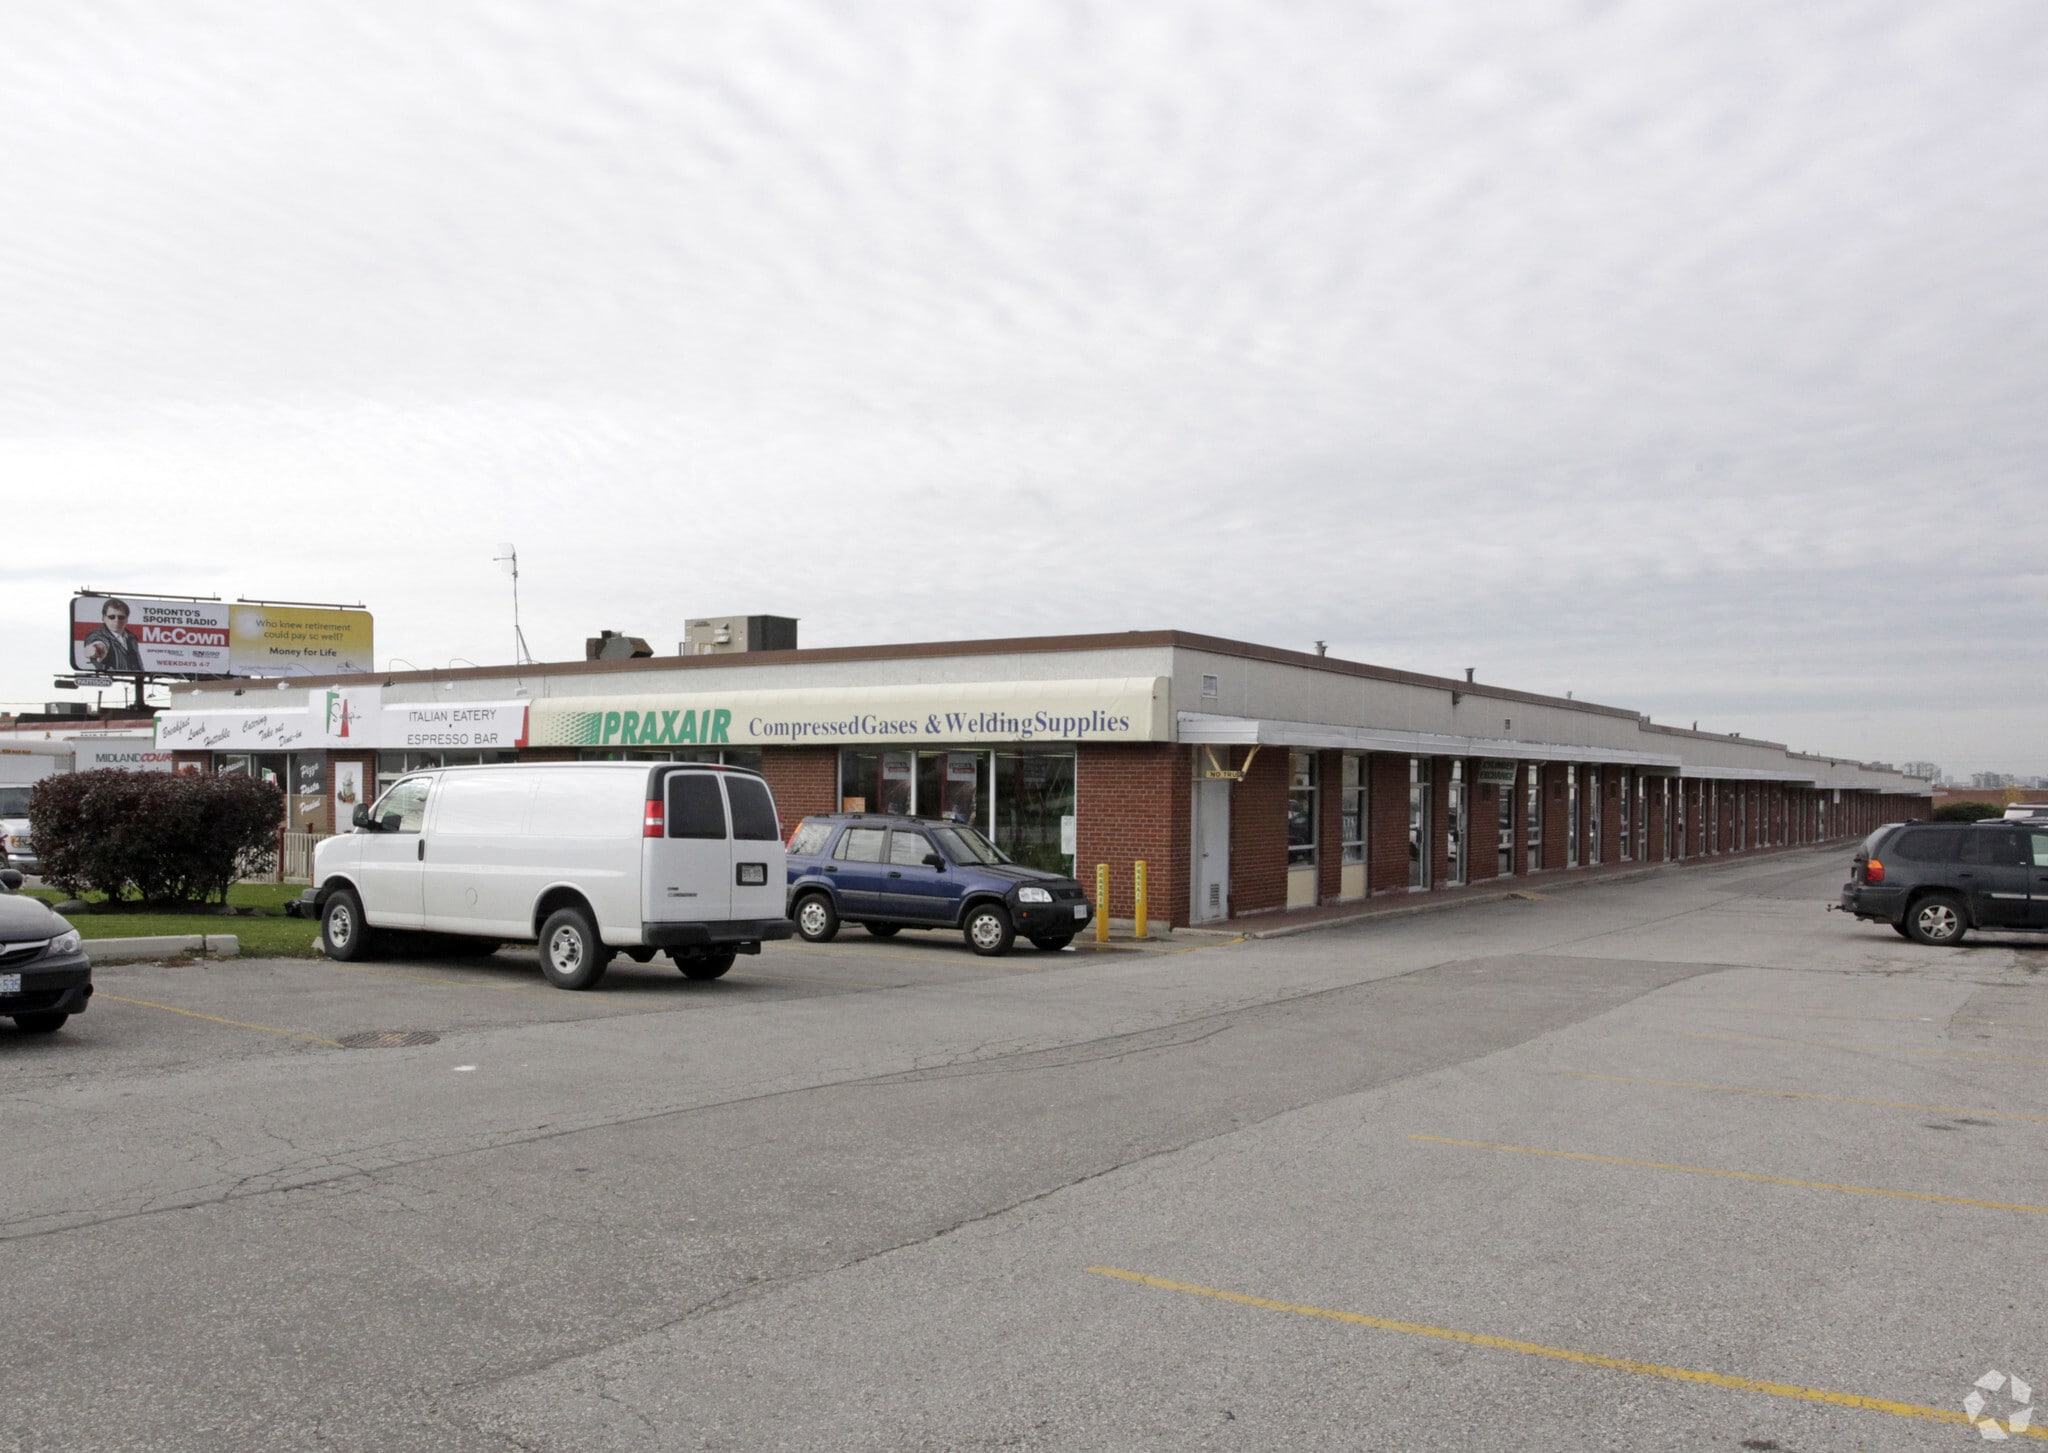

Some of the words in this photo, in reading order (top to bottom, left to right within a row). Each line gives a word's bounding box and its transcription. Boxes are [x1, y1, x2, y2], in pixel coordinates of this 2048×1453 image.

[142, 607, 201, 617] TORONTO'S
[143, 616, 183, 625] SPORTS
[186, 618, 218, 626] RADIO
[256, 619, 277, 628] Who
[280, 620, 303, 629] knew
[305, 621, 351, 631] retirement
[142, 626, 225, 645] McCown
[264, 631, 289, 639] could
[291, 633, 306, 641] pay
[321, 632, 343, 640] well?
[269, 647, 301, 658] Money
[304, 647, 317, 656] for
[320, 648, 337, 657] Life
[409, 711, 448, 723] ITALIAN
[453, 709, 496, 721] EATERY
[925, 713, 942, 734] &
[162, 717, 191, 739] Breakfast
[187, 722, 206, 741] Lunch
[242, 715, 268, 733] Catering
[602, 708, 732, 745] PRAXAIR
[407, 733, 469, 745] ESPRESSO
[474, 733, 498, 744] BAR
[140, 752, 173, 762] COUR
[300, 762, 319, 778] Pizza
[300, 781, 320, 797] Pasta
